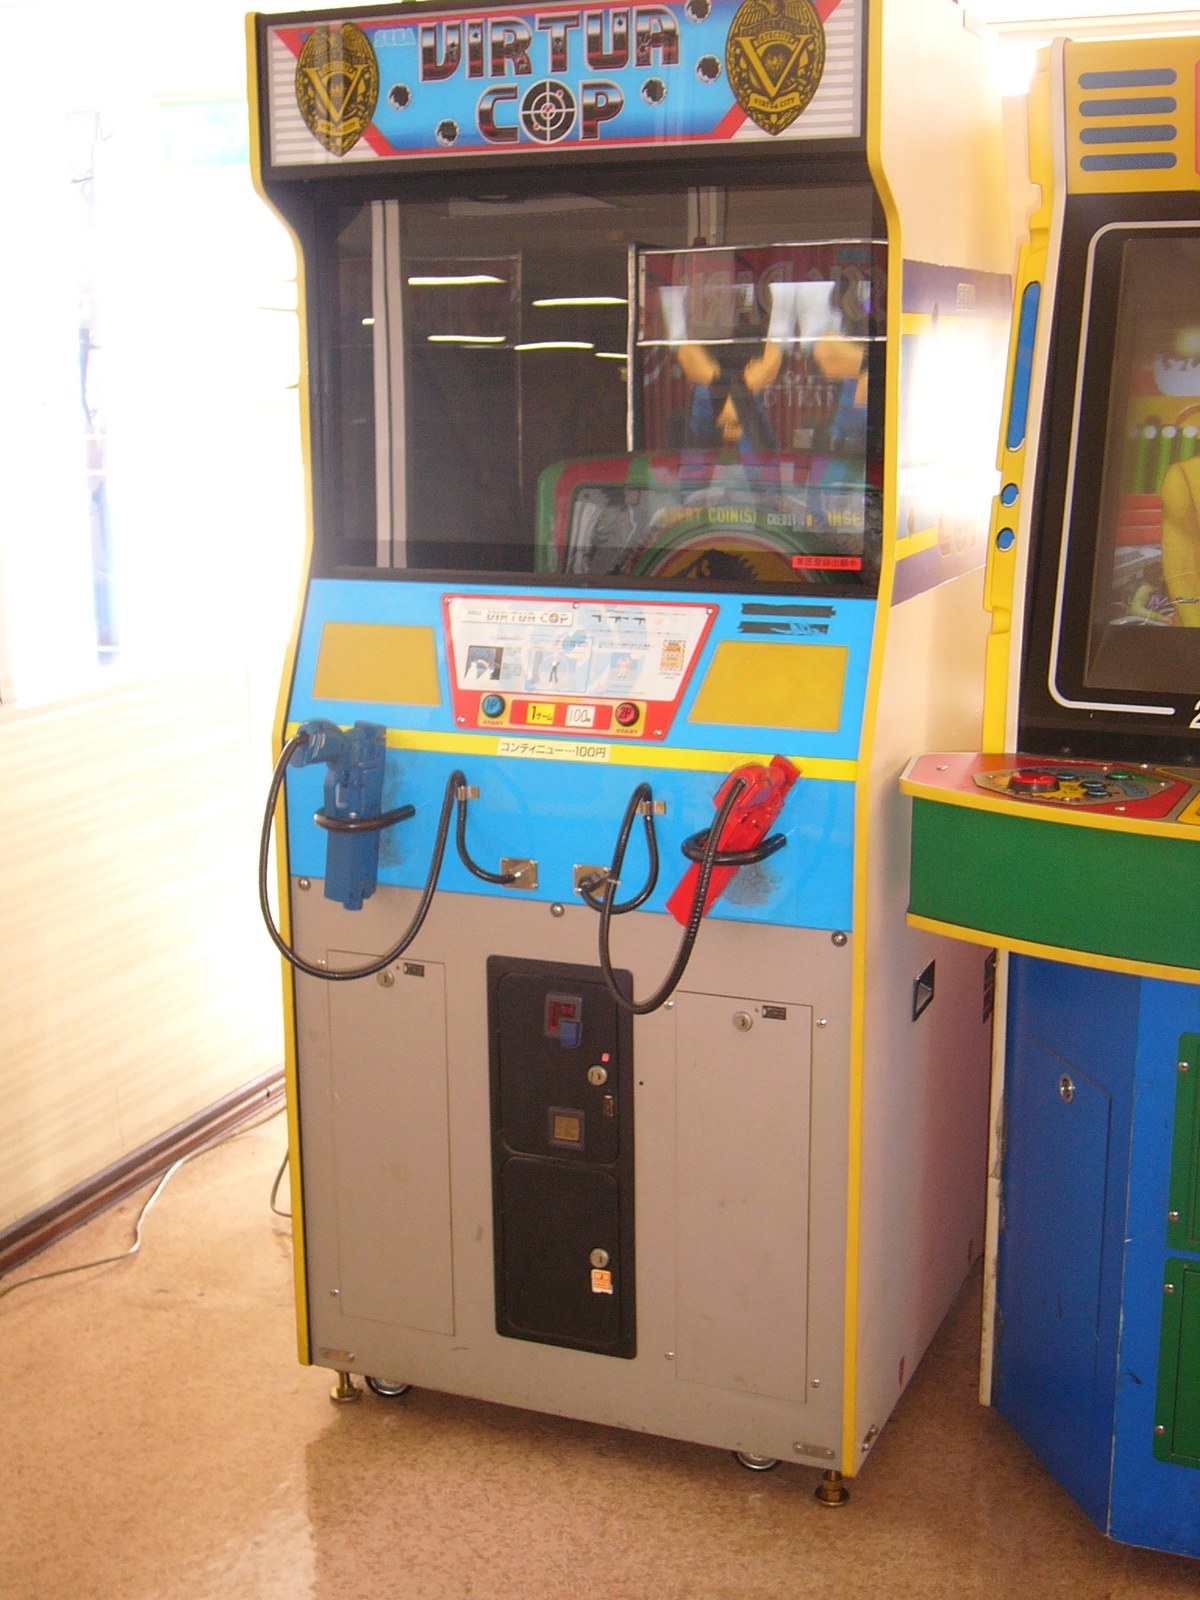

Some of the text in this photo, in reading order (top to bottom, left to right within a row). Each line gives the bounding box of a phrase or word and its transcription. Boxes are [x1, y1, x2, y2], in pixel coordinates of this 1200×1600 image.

[373, 28, 417, 48] SEGA
[418, 7, 680, 84] VIRTUA
[475, 78, 624, 145] COP
